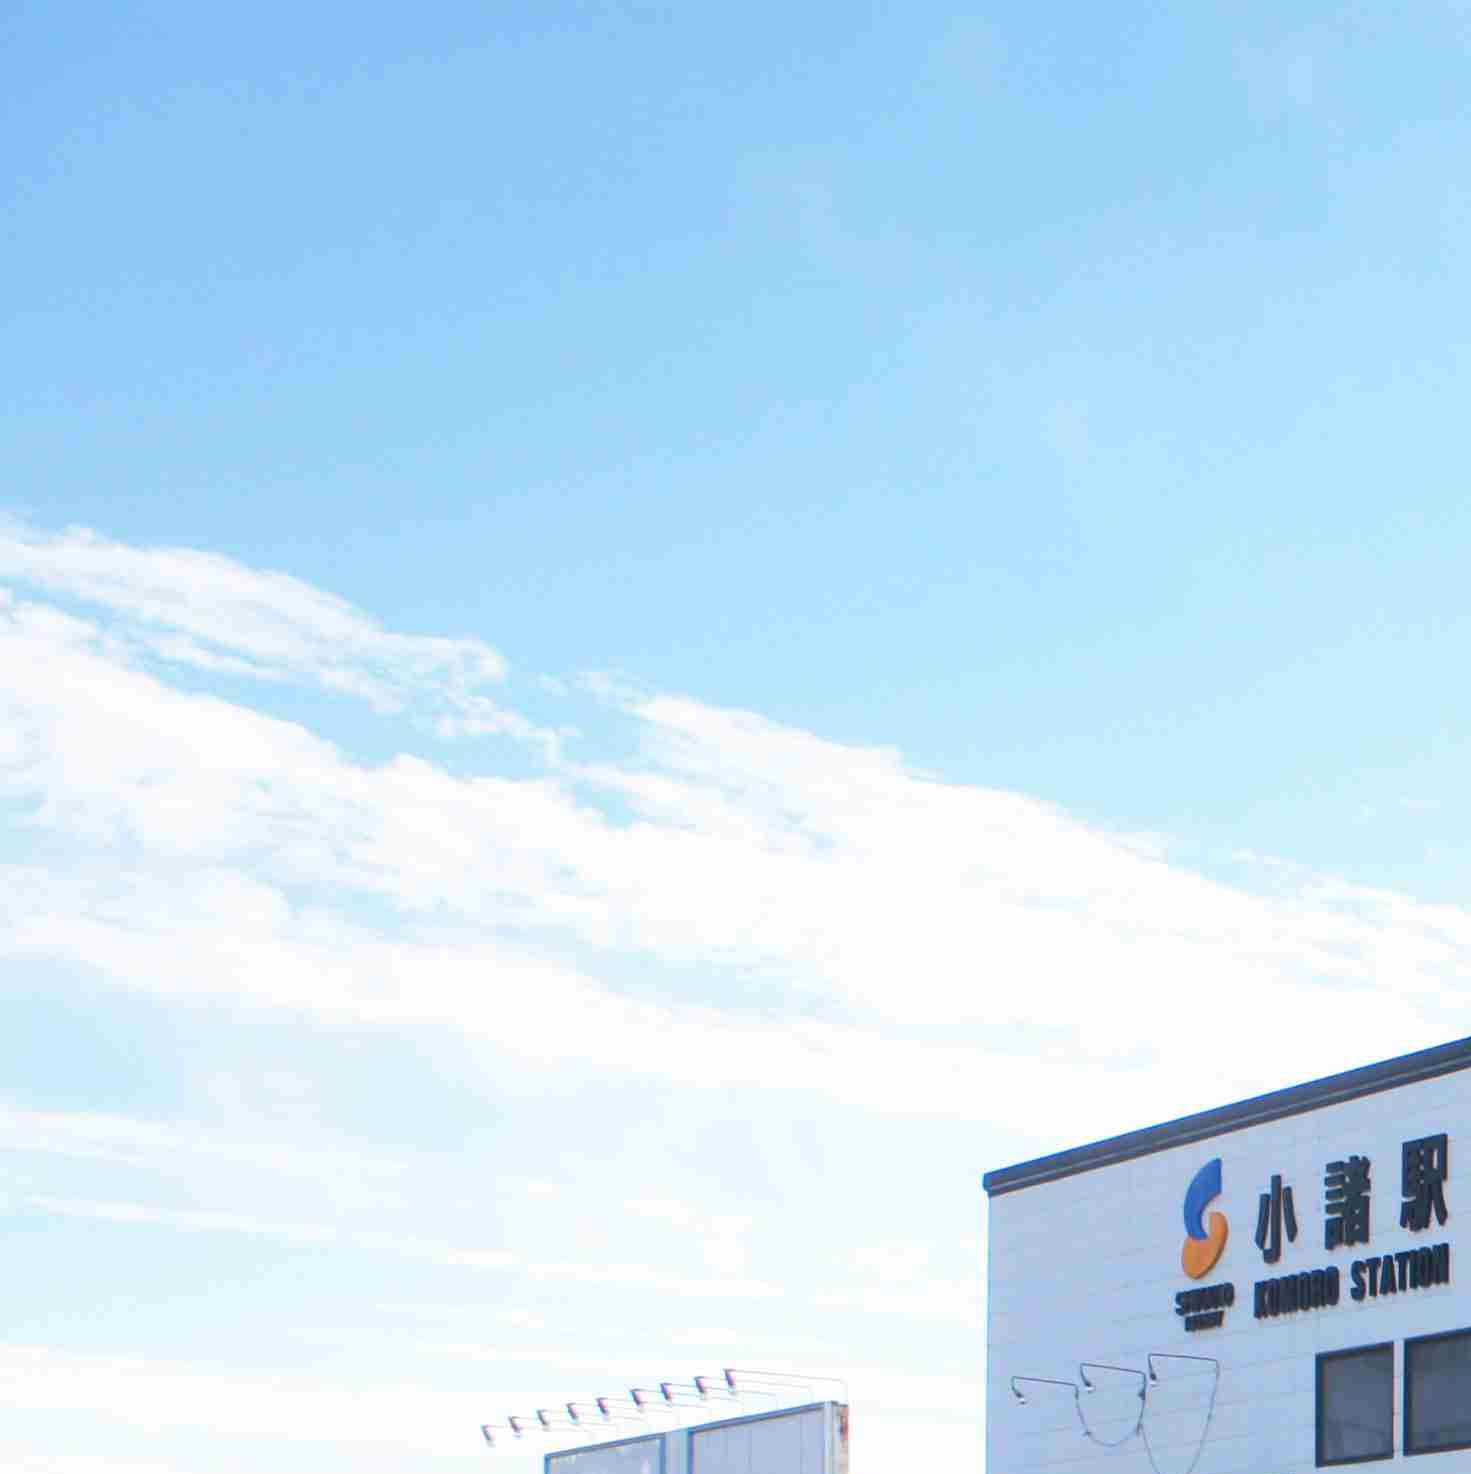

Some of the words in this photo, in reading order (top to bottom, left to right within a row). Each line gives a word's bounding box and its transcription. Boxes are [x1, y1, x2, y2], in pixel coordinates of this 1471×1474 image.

[1255, 1133, 1449, 1264] 小諸駅
[1350, 1242, 1450, 1302] STATION
